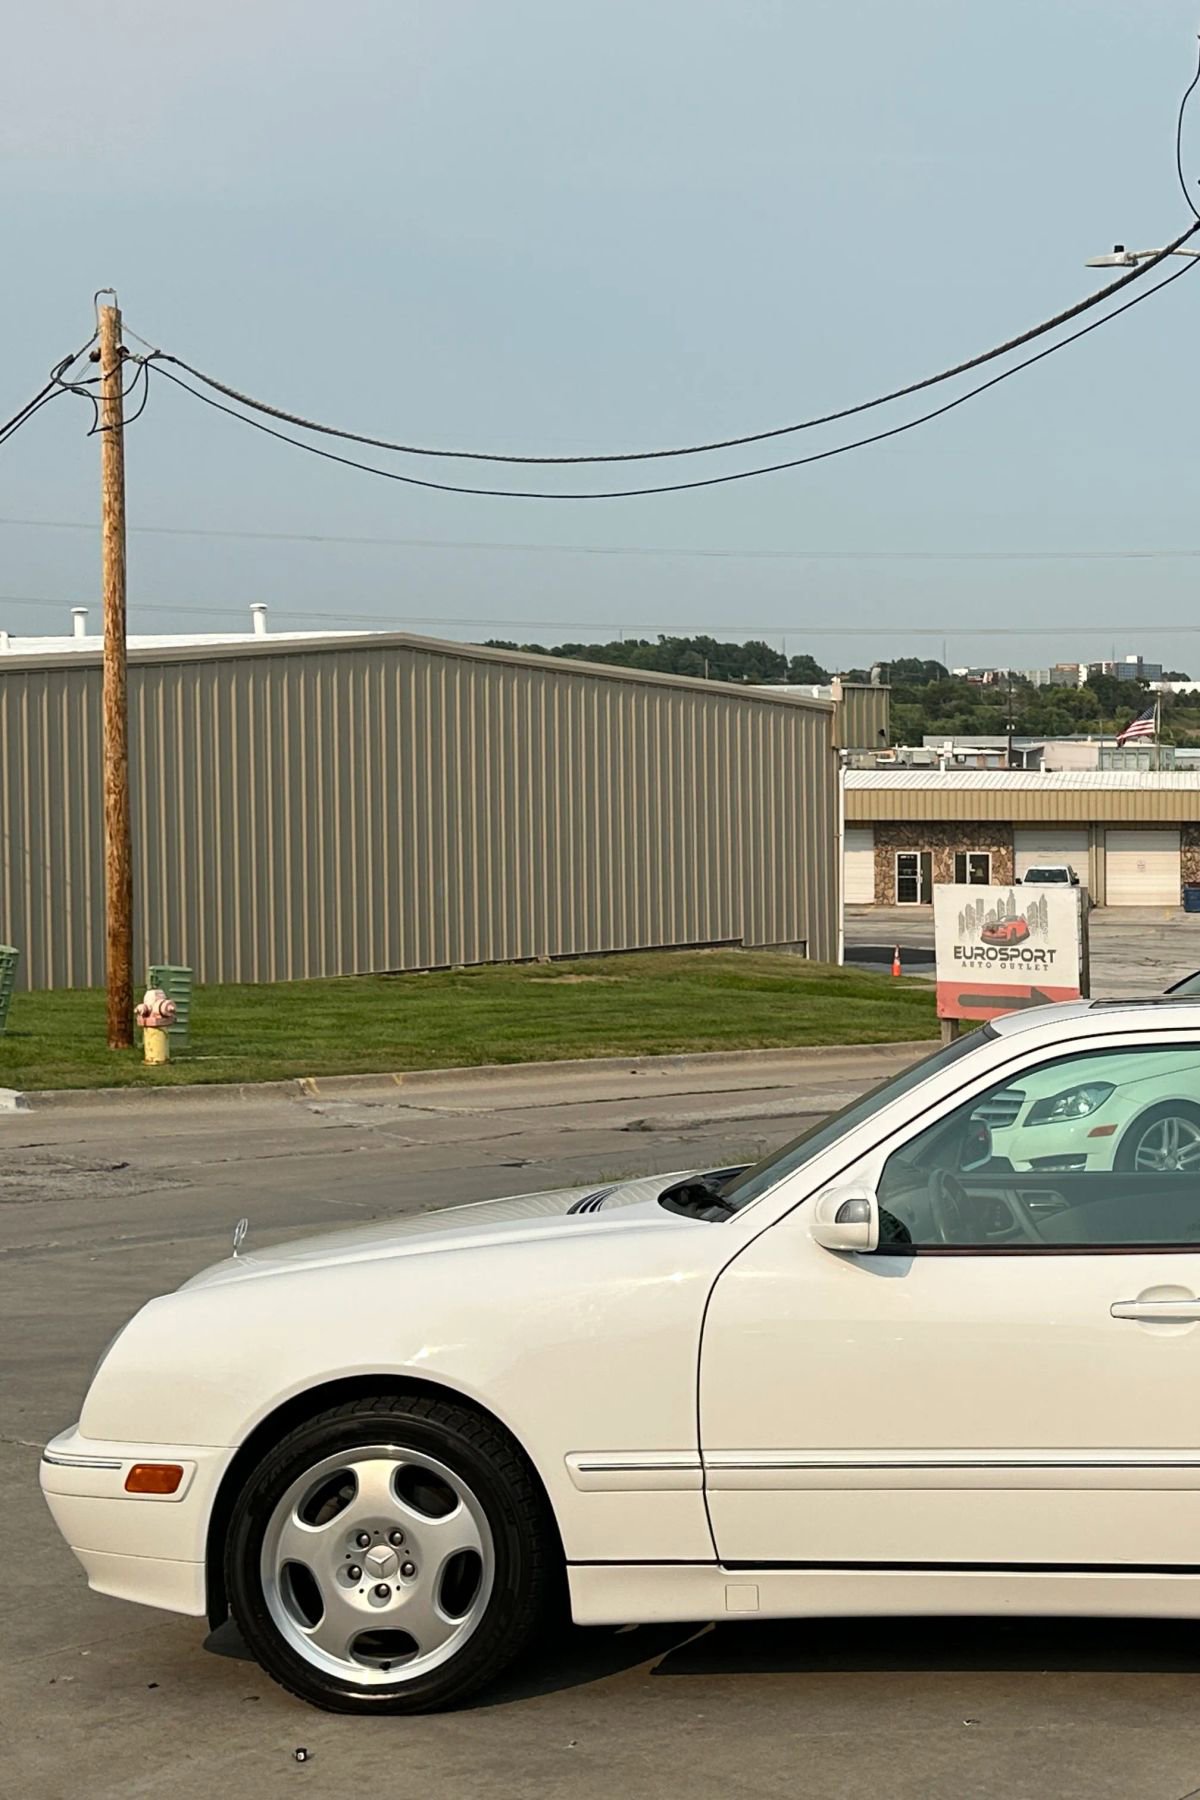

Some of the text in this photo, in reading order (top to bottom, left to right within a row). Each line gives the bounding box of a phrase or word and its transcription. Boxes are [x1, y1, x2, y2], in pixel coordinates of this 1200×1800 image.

[953, 945, 1056, 963] EUROSPORT
[962, 961, 1049, 971] AUTO OUTLET
